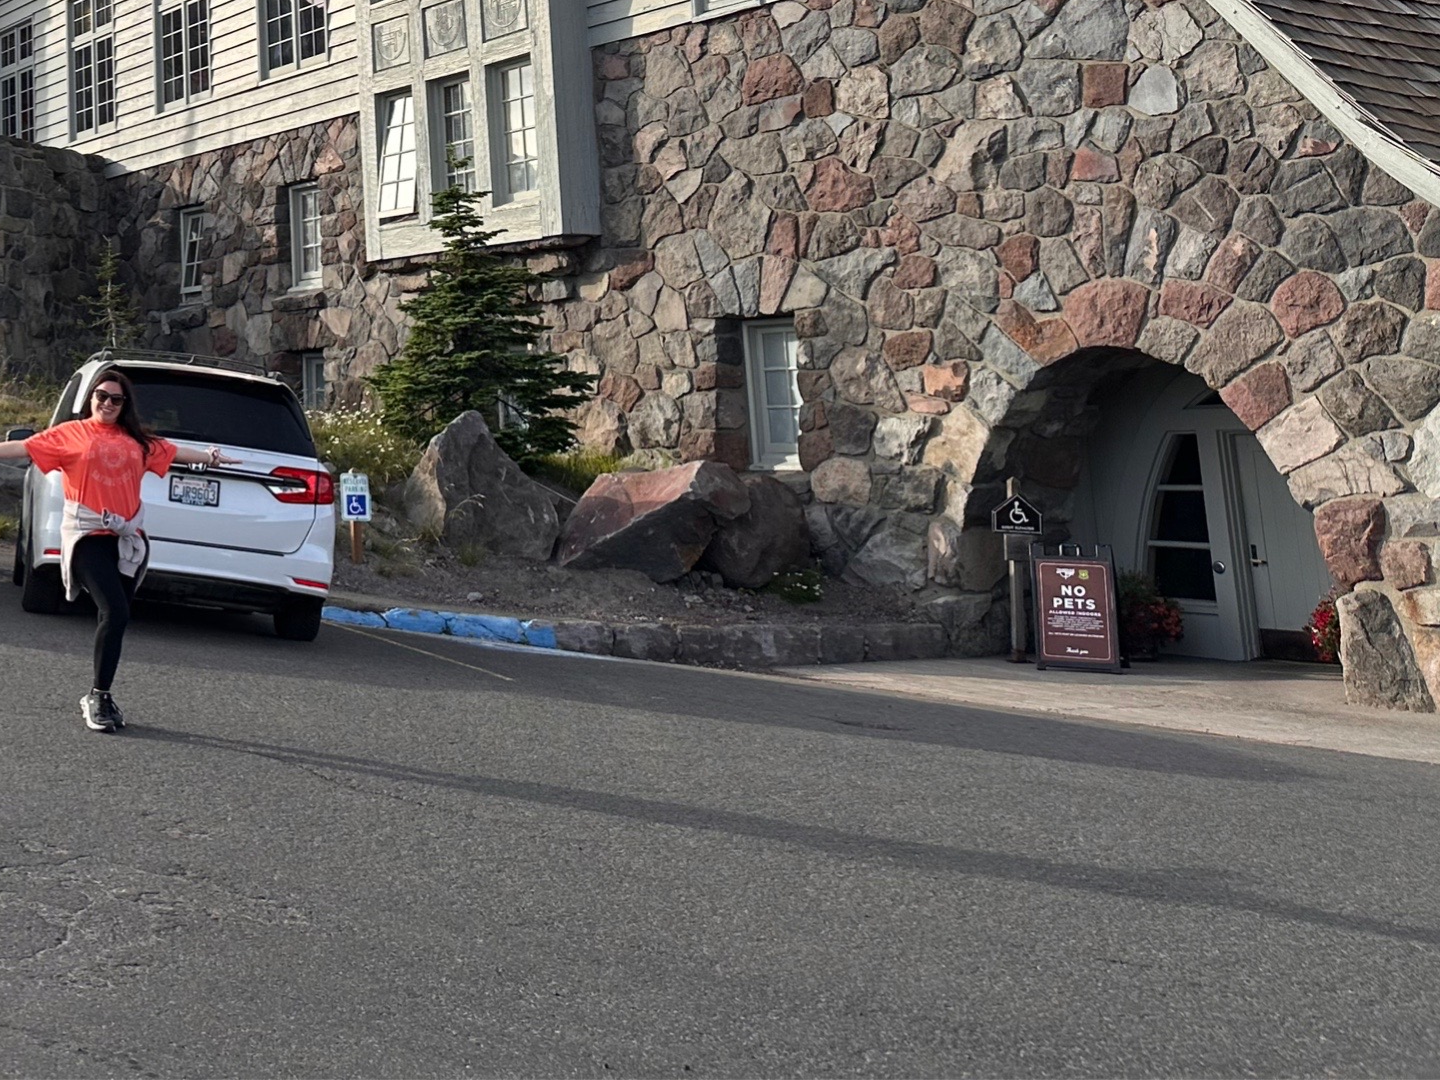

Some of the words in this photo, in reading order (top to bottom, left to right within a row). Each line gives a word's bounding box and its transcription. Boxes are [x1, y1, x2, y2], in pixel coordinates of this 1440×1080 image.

[173, 484, 216, 502] CJR9603
[1061, 584, 1086, 597] NO
[1052, 597, 1096, 610] PETS
